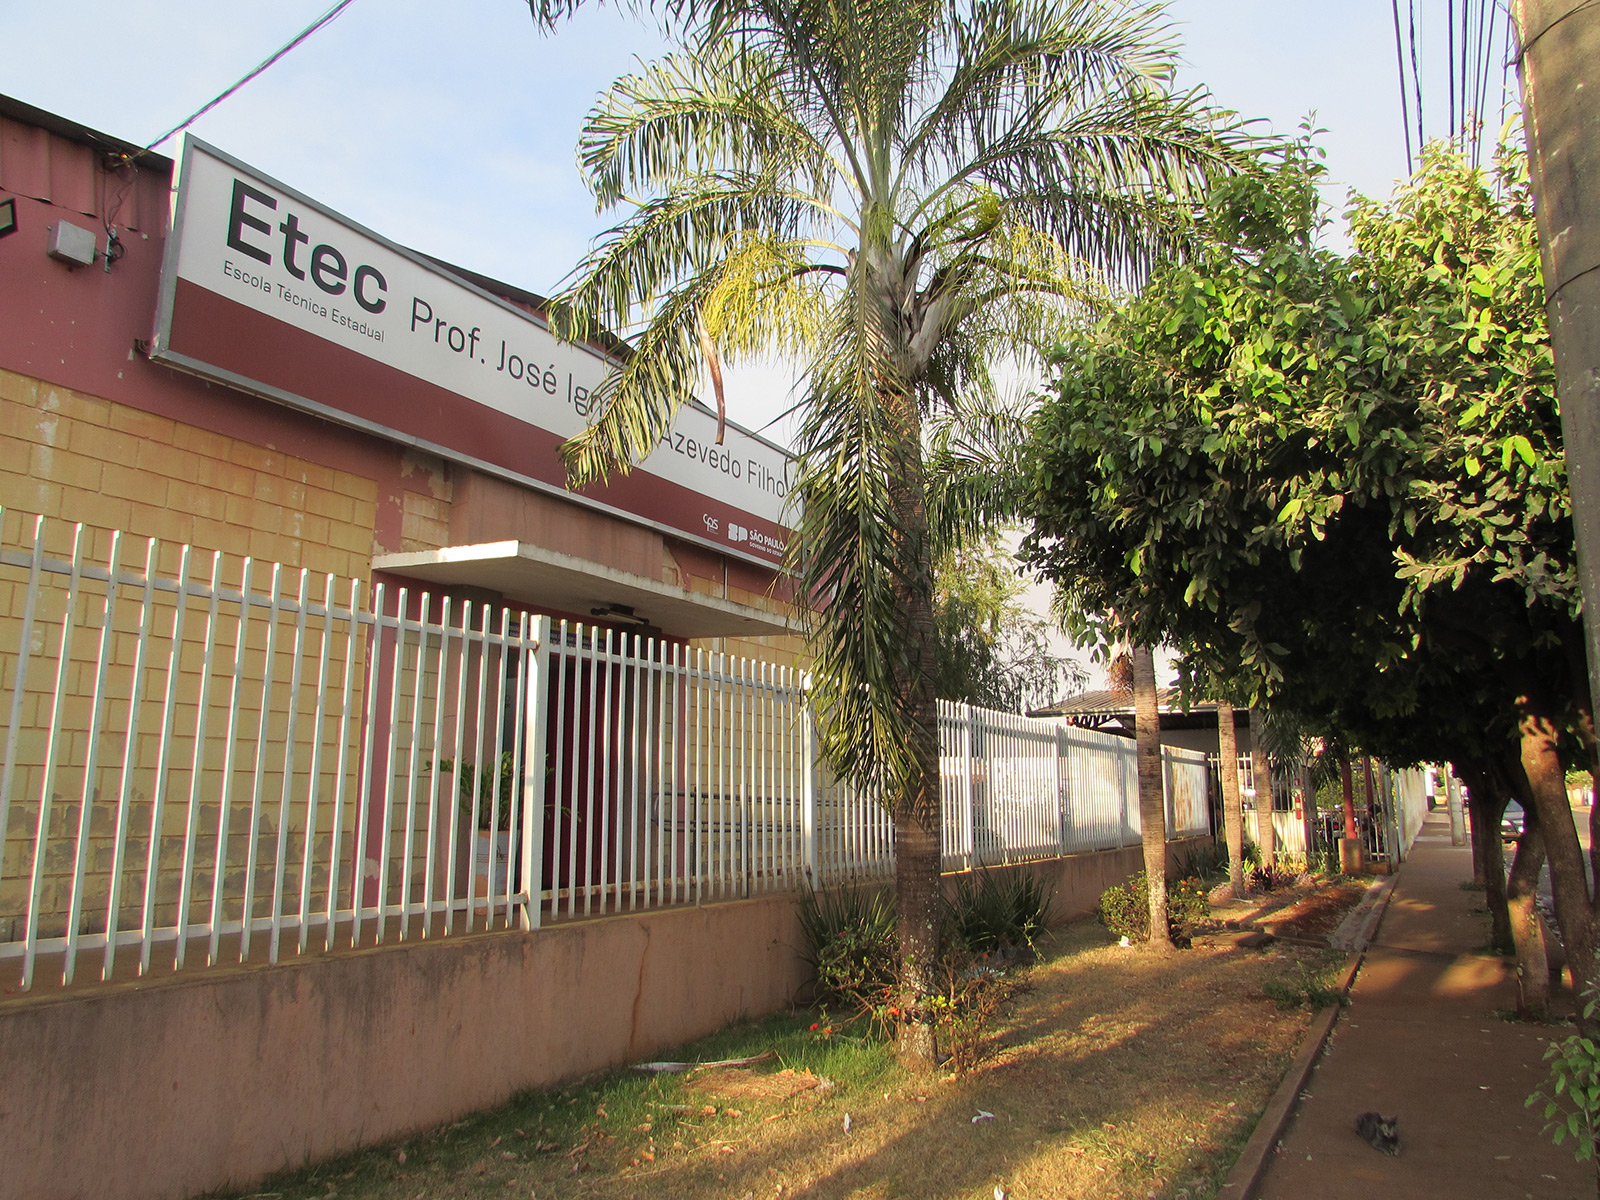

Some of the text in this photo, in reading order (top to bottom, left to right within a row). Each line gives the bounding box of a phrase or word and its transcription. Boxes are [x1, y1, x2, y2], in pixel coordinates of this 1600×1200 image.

[223, 260, 385, 342] Escola Técnica Estadual
[227, 178, 388, 314] Etec
[410, 297, 485, 364] Prof.
[496, 340, 557, 395] José
[747, 459, 785, 498] Filho
[749, 529, 785, 551] SÃO PAULO
